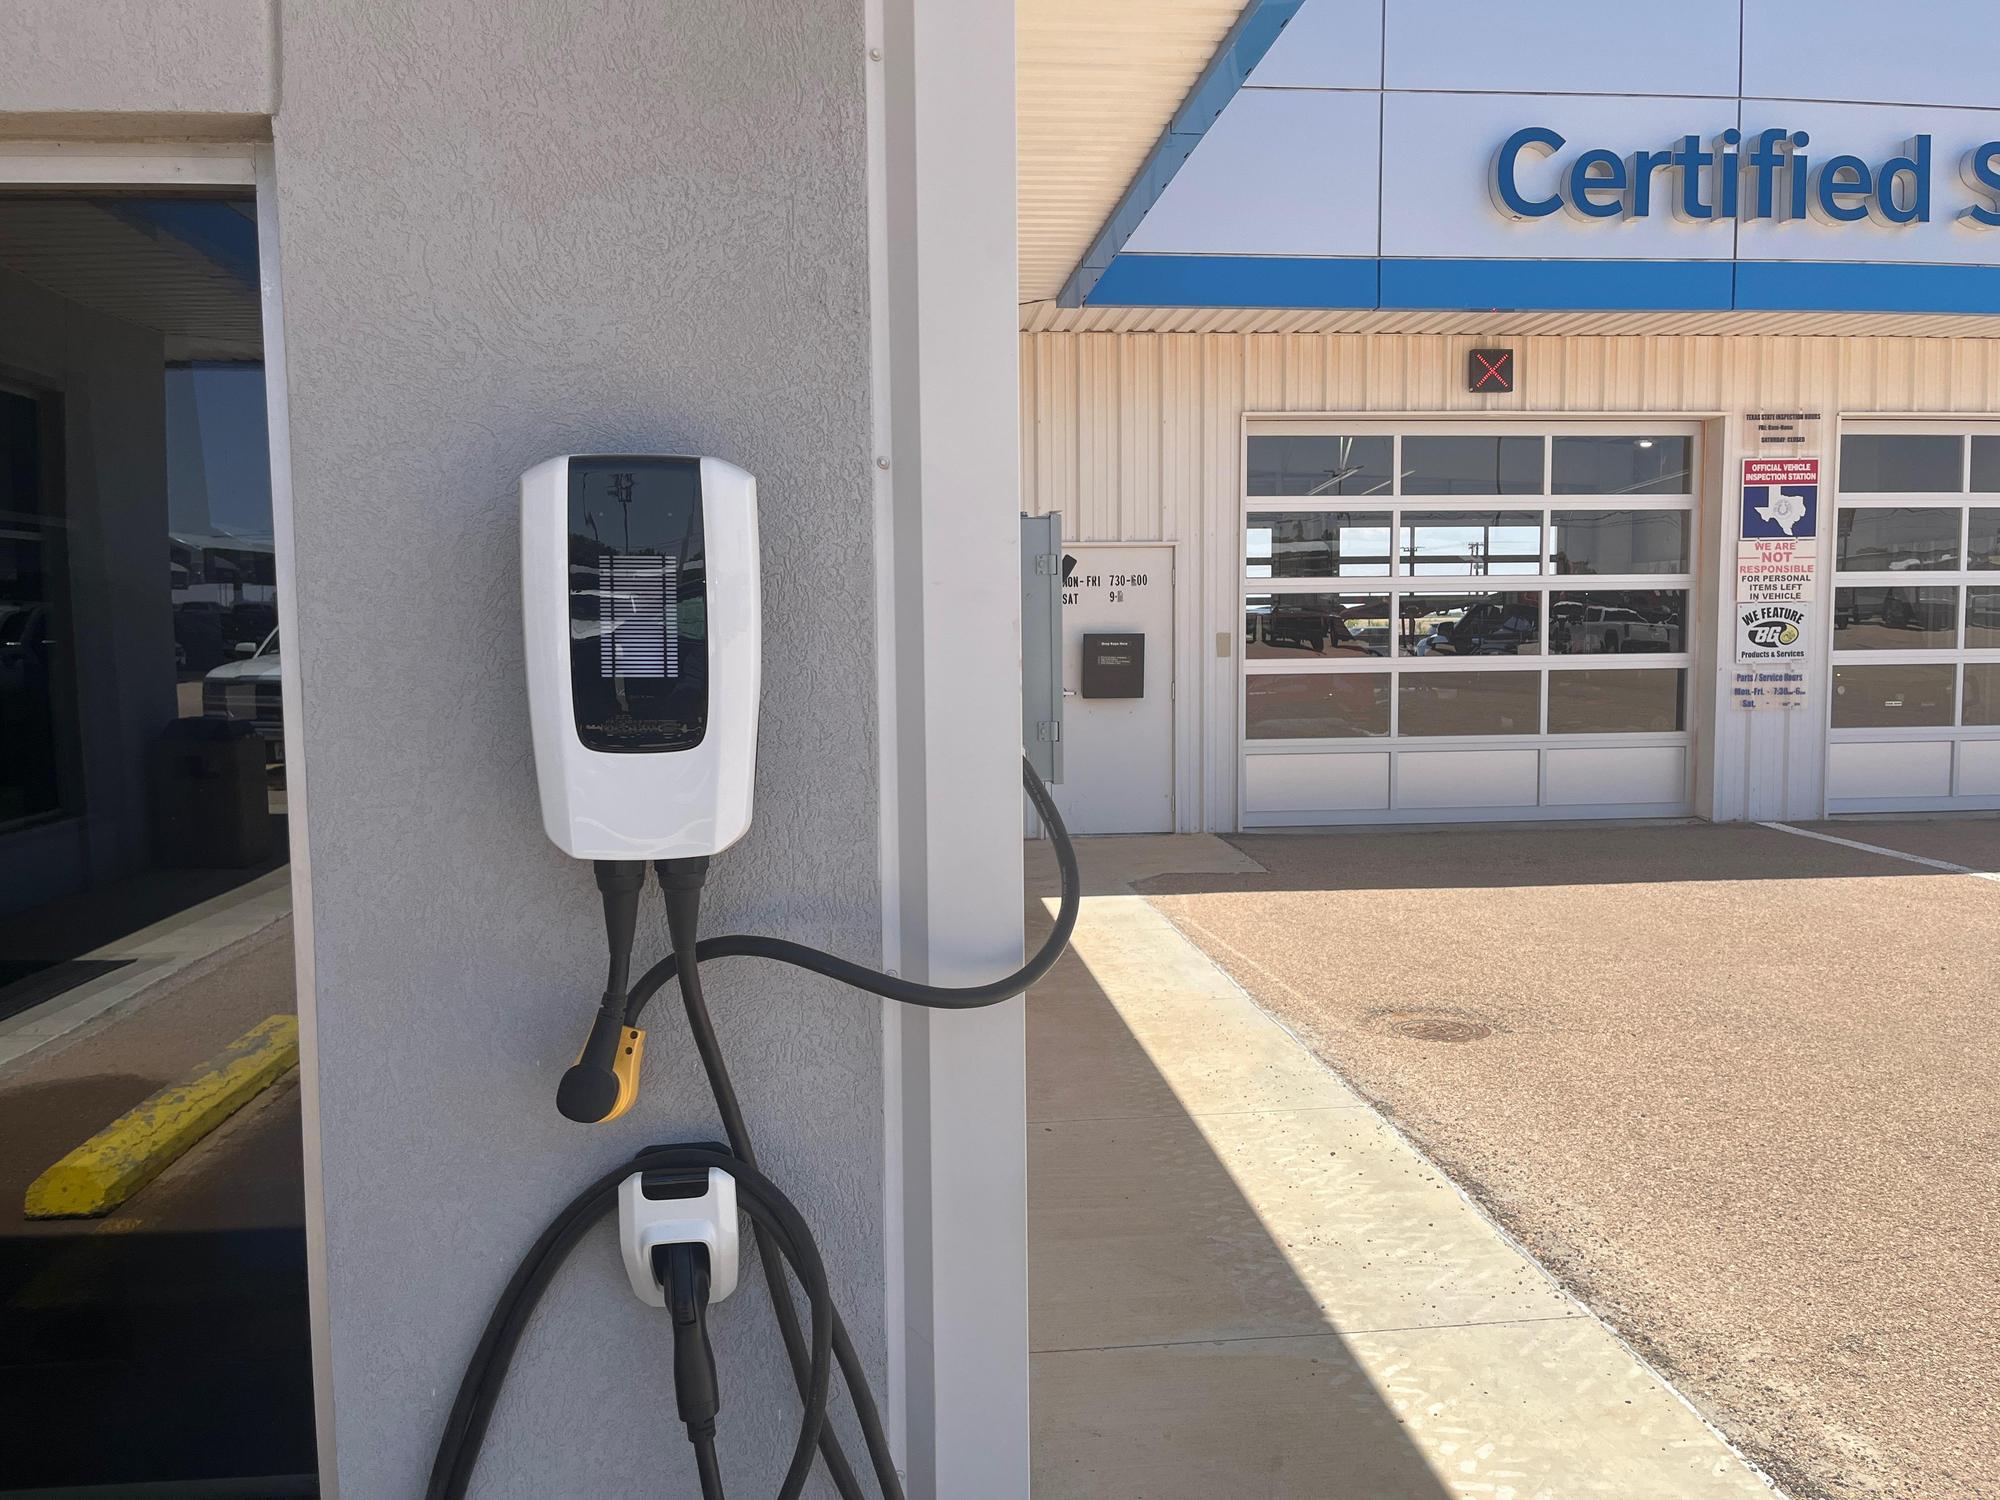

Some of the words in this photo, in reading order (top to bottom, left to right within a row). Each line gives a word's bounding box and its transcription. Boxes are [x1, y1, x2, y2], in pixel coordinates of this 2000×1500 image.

[1497, 126, 1932, 224] Certified
[1783, 463, 1811, 471] VEHICLE
[1745, 473, 1787, 481] INSPECTION
[1762, 552, 1792, 562] NOT
[1740, 565, 1814, 573] RESPONSIBLE
[1062, 593, 1079, 605] SAT
[1741, 610, 1760, 626] WE
[1761, 607, 1805, 624] FEATURE
[1754, 626, 1782, 643] BG
[1737, 673, 1753, 682] Parts
[1759, 673, 1783, 681] Service
[1784, 673, 1803, 681] Hours
